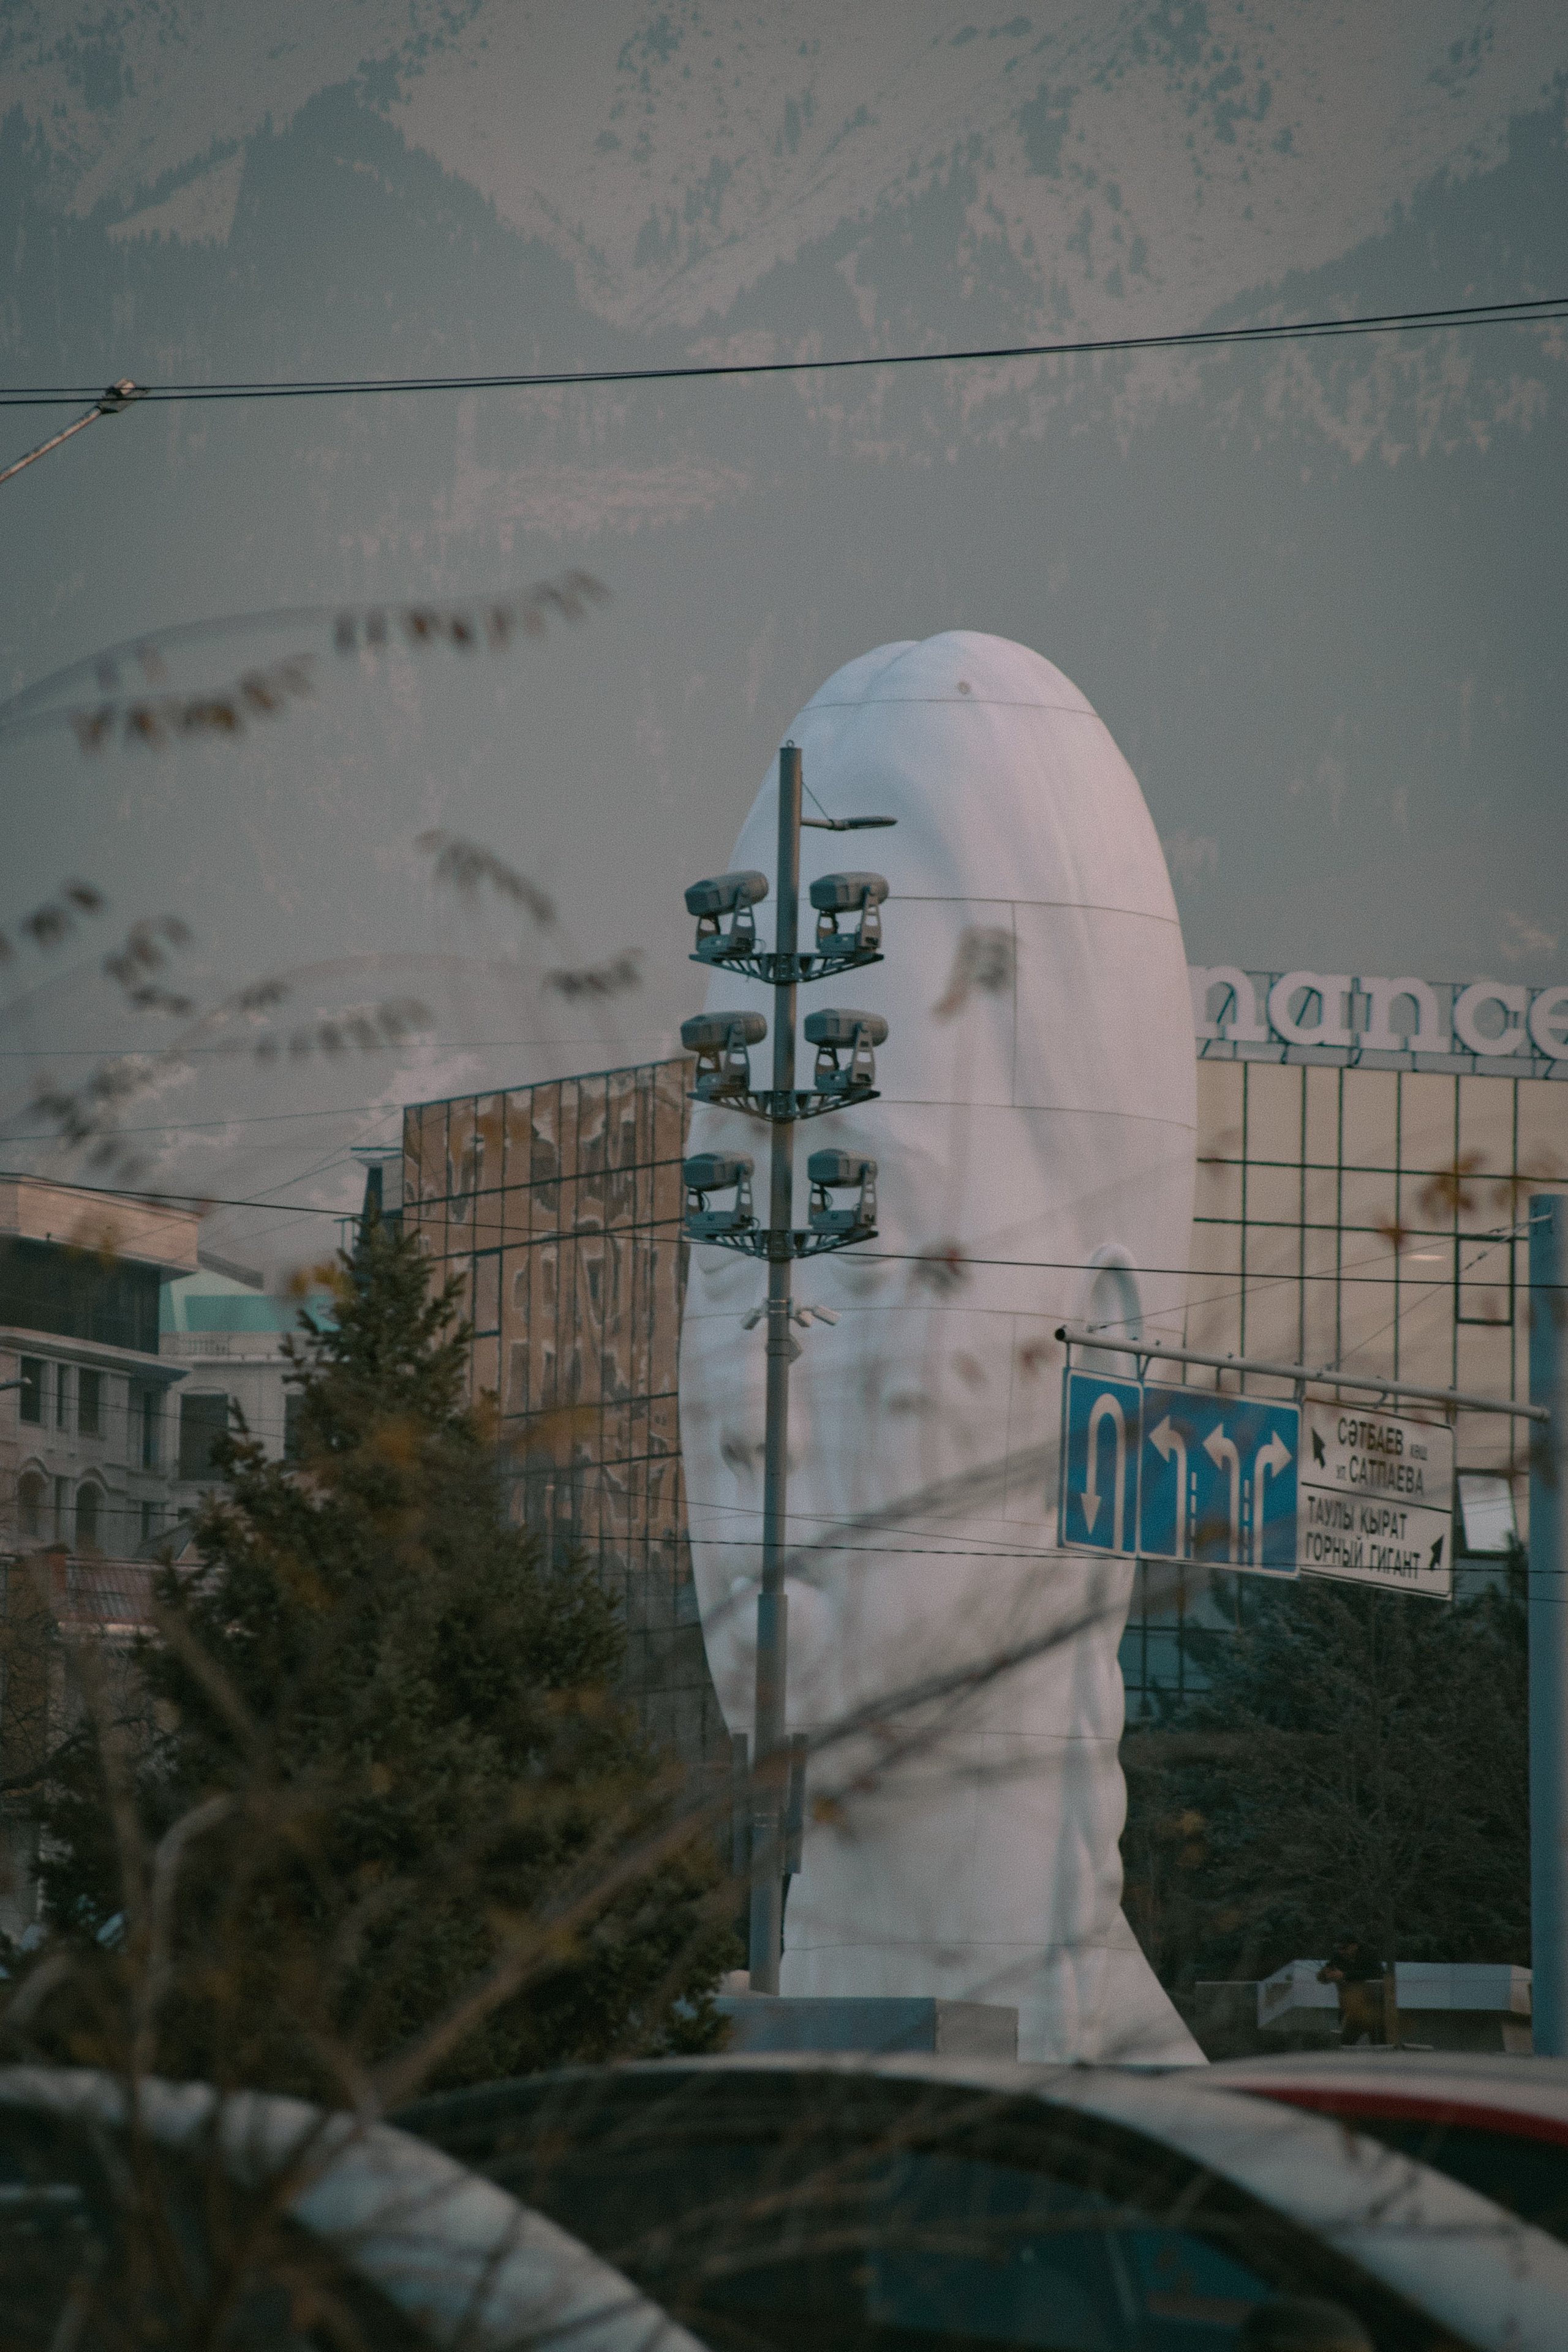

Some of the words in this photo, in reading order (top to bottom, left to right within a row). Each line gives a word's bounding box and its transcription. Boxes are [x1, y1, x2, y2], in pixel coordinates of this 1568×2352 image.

[1338, 1417, 1404, 1457] СӘТБАЕВ
[1349, 1455, 1425, 1495] САТПАЕВА
[1307, 1495, 1354, 1531] ТАУЛЫ
[1360, 1505, 1408, 1540] ҚЫРАТ
[1305, 1531, 1364, 1568] ГОРНЫЙ
[1370, 1545, 1421, 1579] ГИГАНТ
